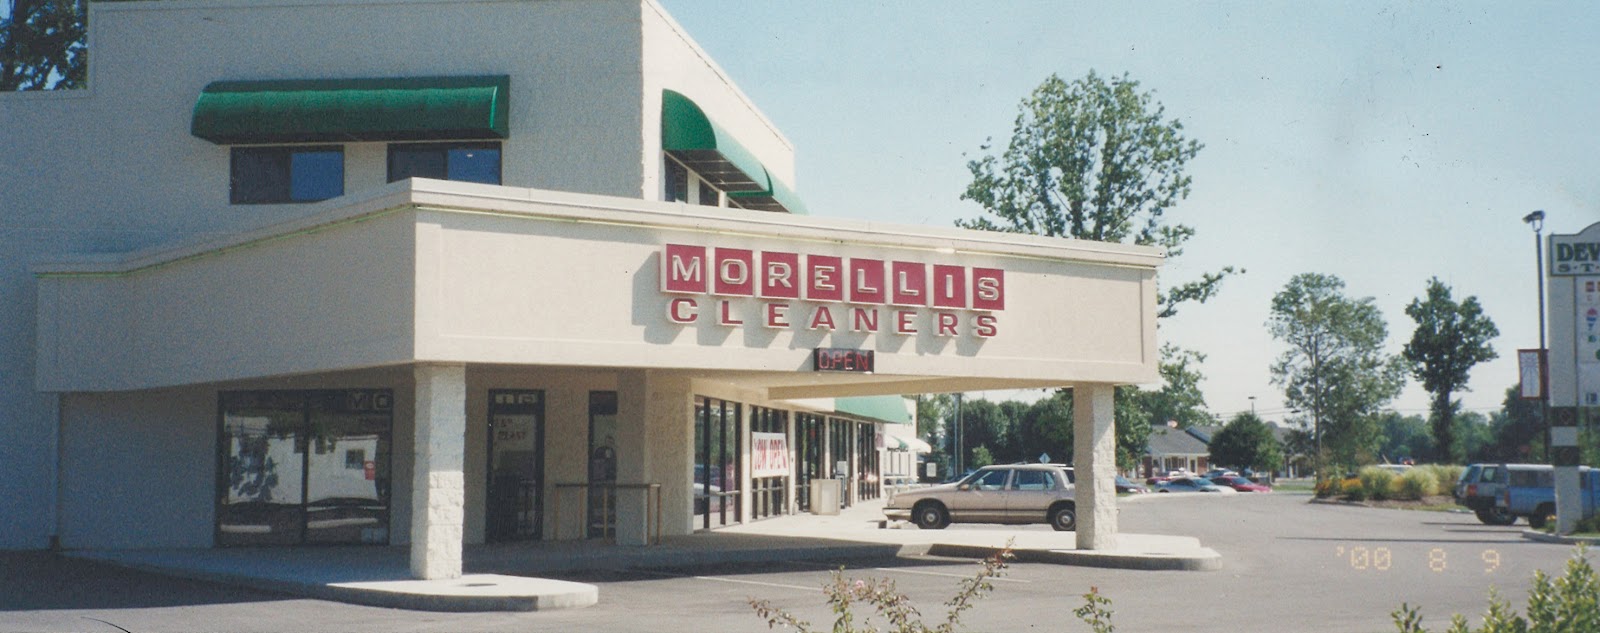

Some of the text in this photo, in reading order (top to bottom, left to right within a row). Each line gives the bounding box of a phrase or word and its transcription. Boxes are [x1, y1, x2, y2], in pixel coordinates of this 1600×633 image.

[669, 253, 1002, 303] MORELLIS
[667, 297, 998, 338] CLEANERS
[818, 350, 869, 371] OPEN
